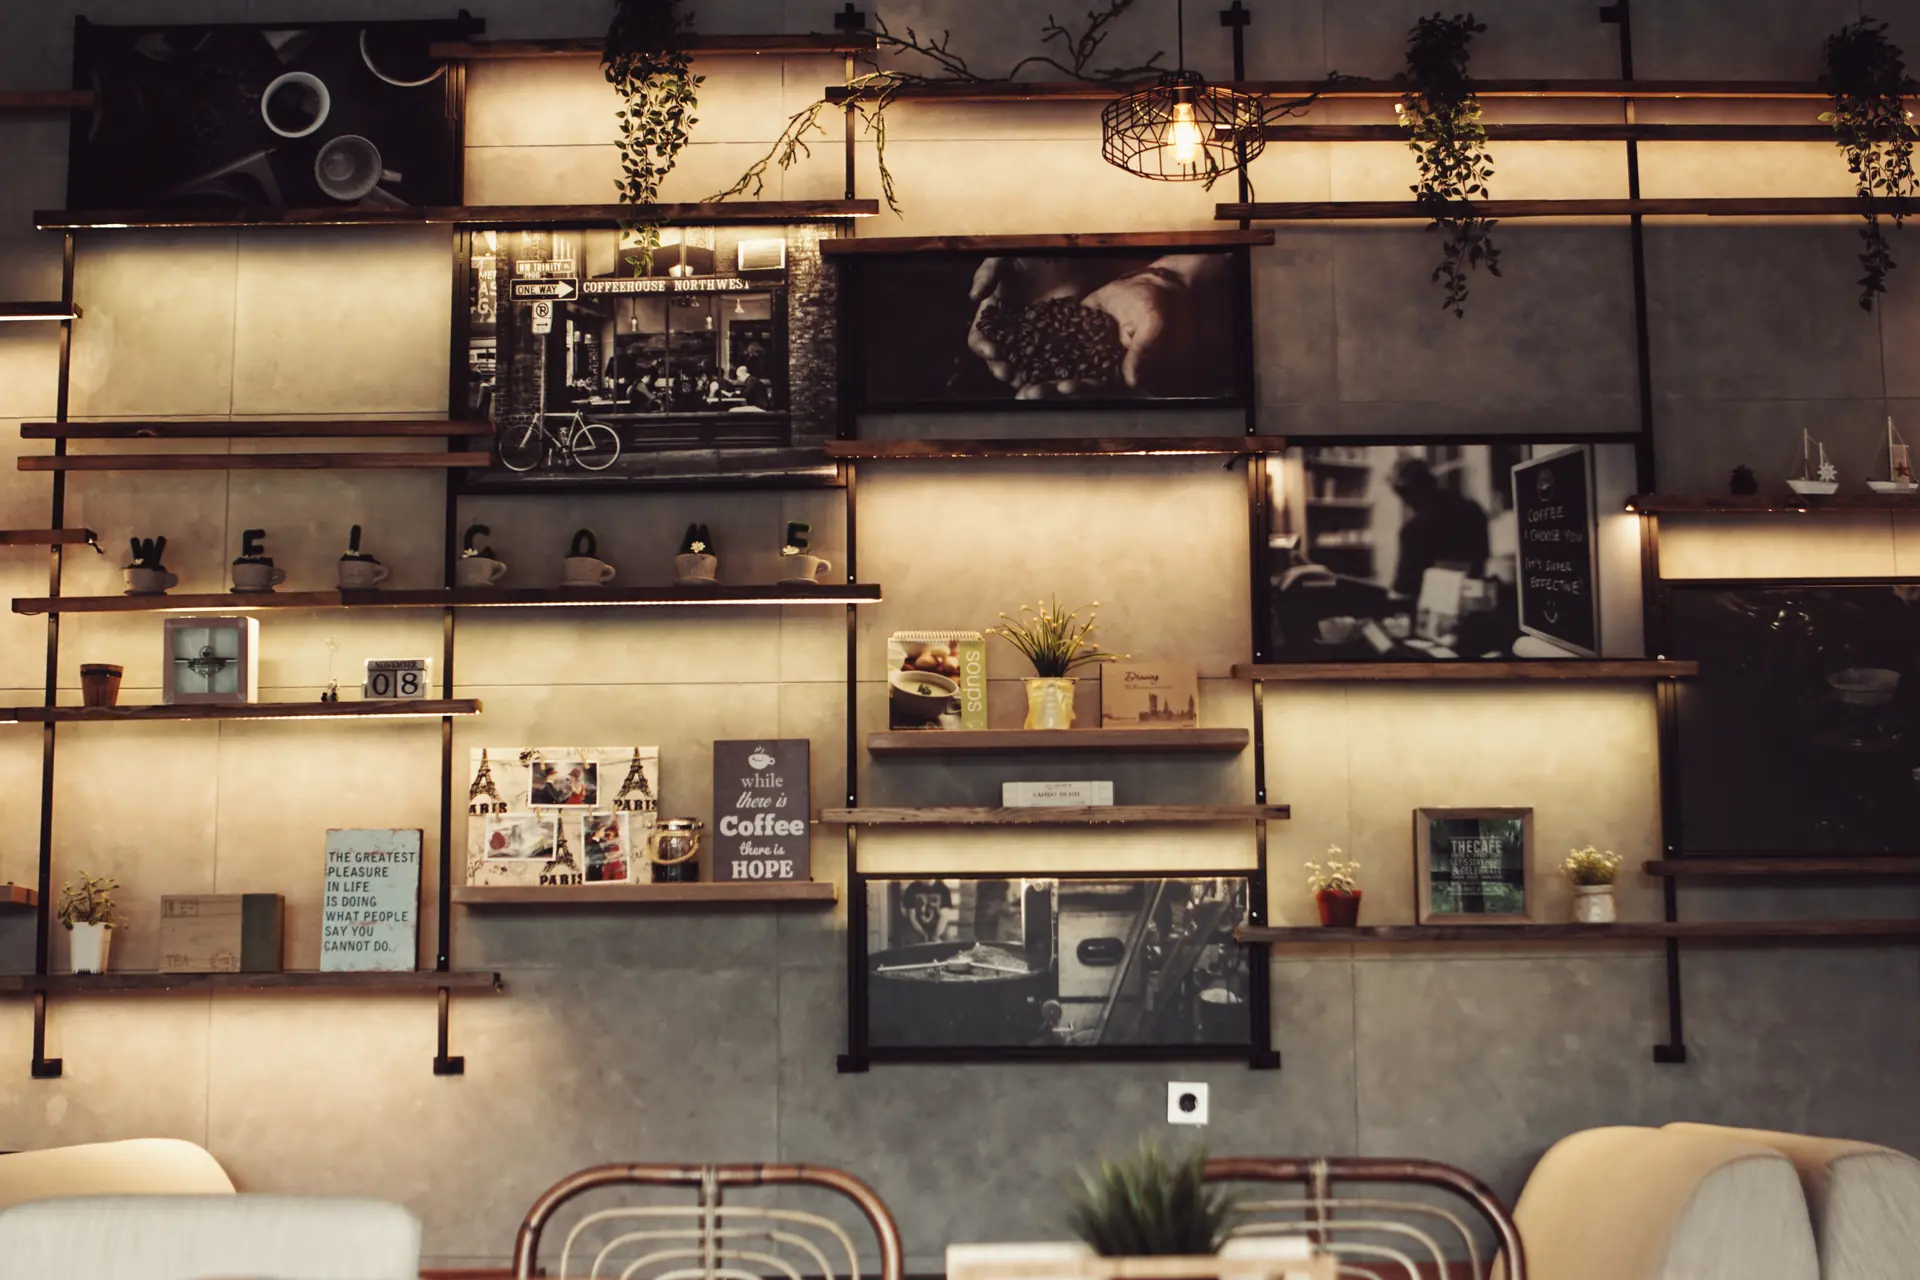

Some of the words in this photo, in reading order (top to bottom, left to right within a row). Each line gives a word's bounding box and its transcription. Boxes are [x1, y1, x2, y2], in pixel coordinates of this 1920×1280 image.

[533, 262, 561, 272] TRINITY
[517, 285, 536, 295] ONE
[539, 284, 558, 294] WAY
[583, 280, 666, 293] COFFEEHOUSE
[674, 278, 750, 291] NORTHWEST
[962, 650, 982, 712] soups
[741, 773, 784, 788] while
[613, 799, 658, 811] PARIS
[736, 791, 772, 809] there
[776, 793, 787, 808] is
[720, 813, 804, 837] Coffee
[739, 841, 772, 856] there
[773, 844, 785, 855] is
[329, 852, 351, 863] THE
[355, 852, 415, 863] GREATEST
[328, 866, 389, 877] PLEASURE
[732, 860, 794, 879] HOPE
[540, 873, 582, 885] PARIS
[327, 882, 339, 892] IN
[344, 881, 370, 892] LIFE
[326, 896, 338, 907] IS
[342, 896, 377, 907] DOING
[325, 911, 359, 922] WHAT
[364, 911, 408, 922] PEOPLE
[325, 926, 347, 937] SAY
[351, 926, 374, 937] YOU
[324, 940, 370, 952] CANNOT
[374, 940, 392, 952] DO.
[165, 954, 188, 967] TEA
